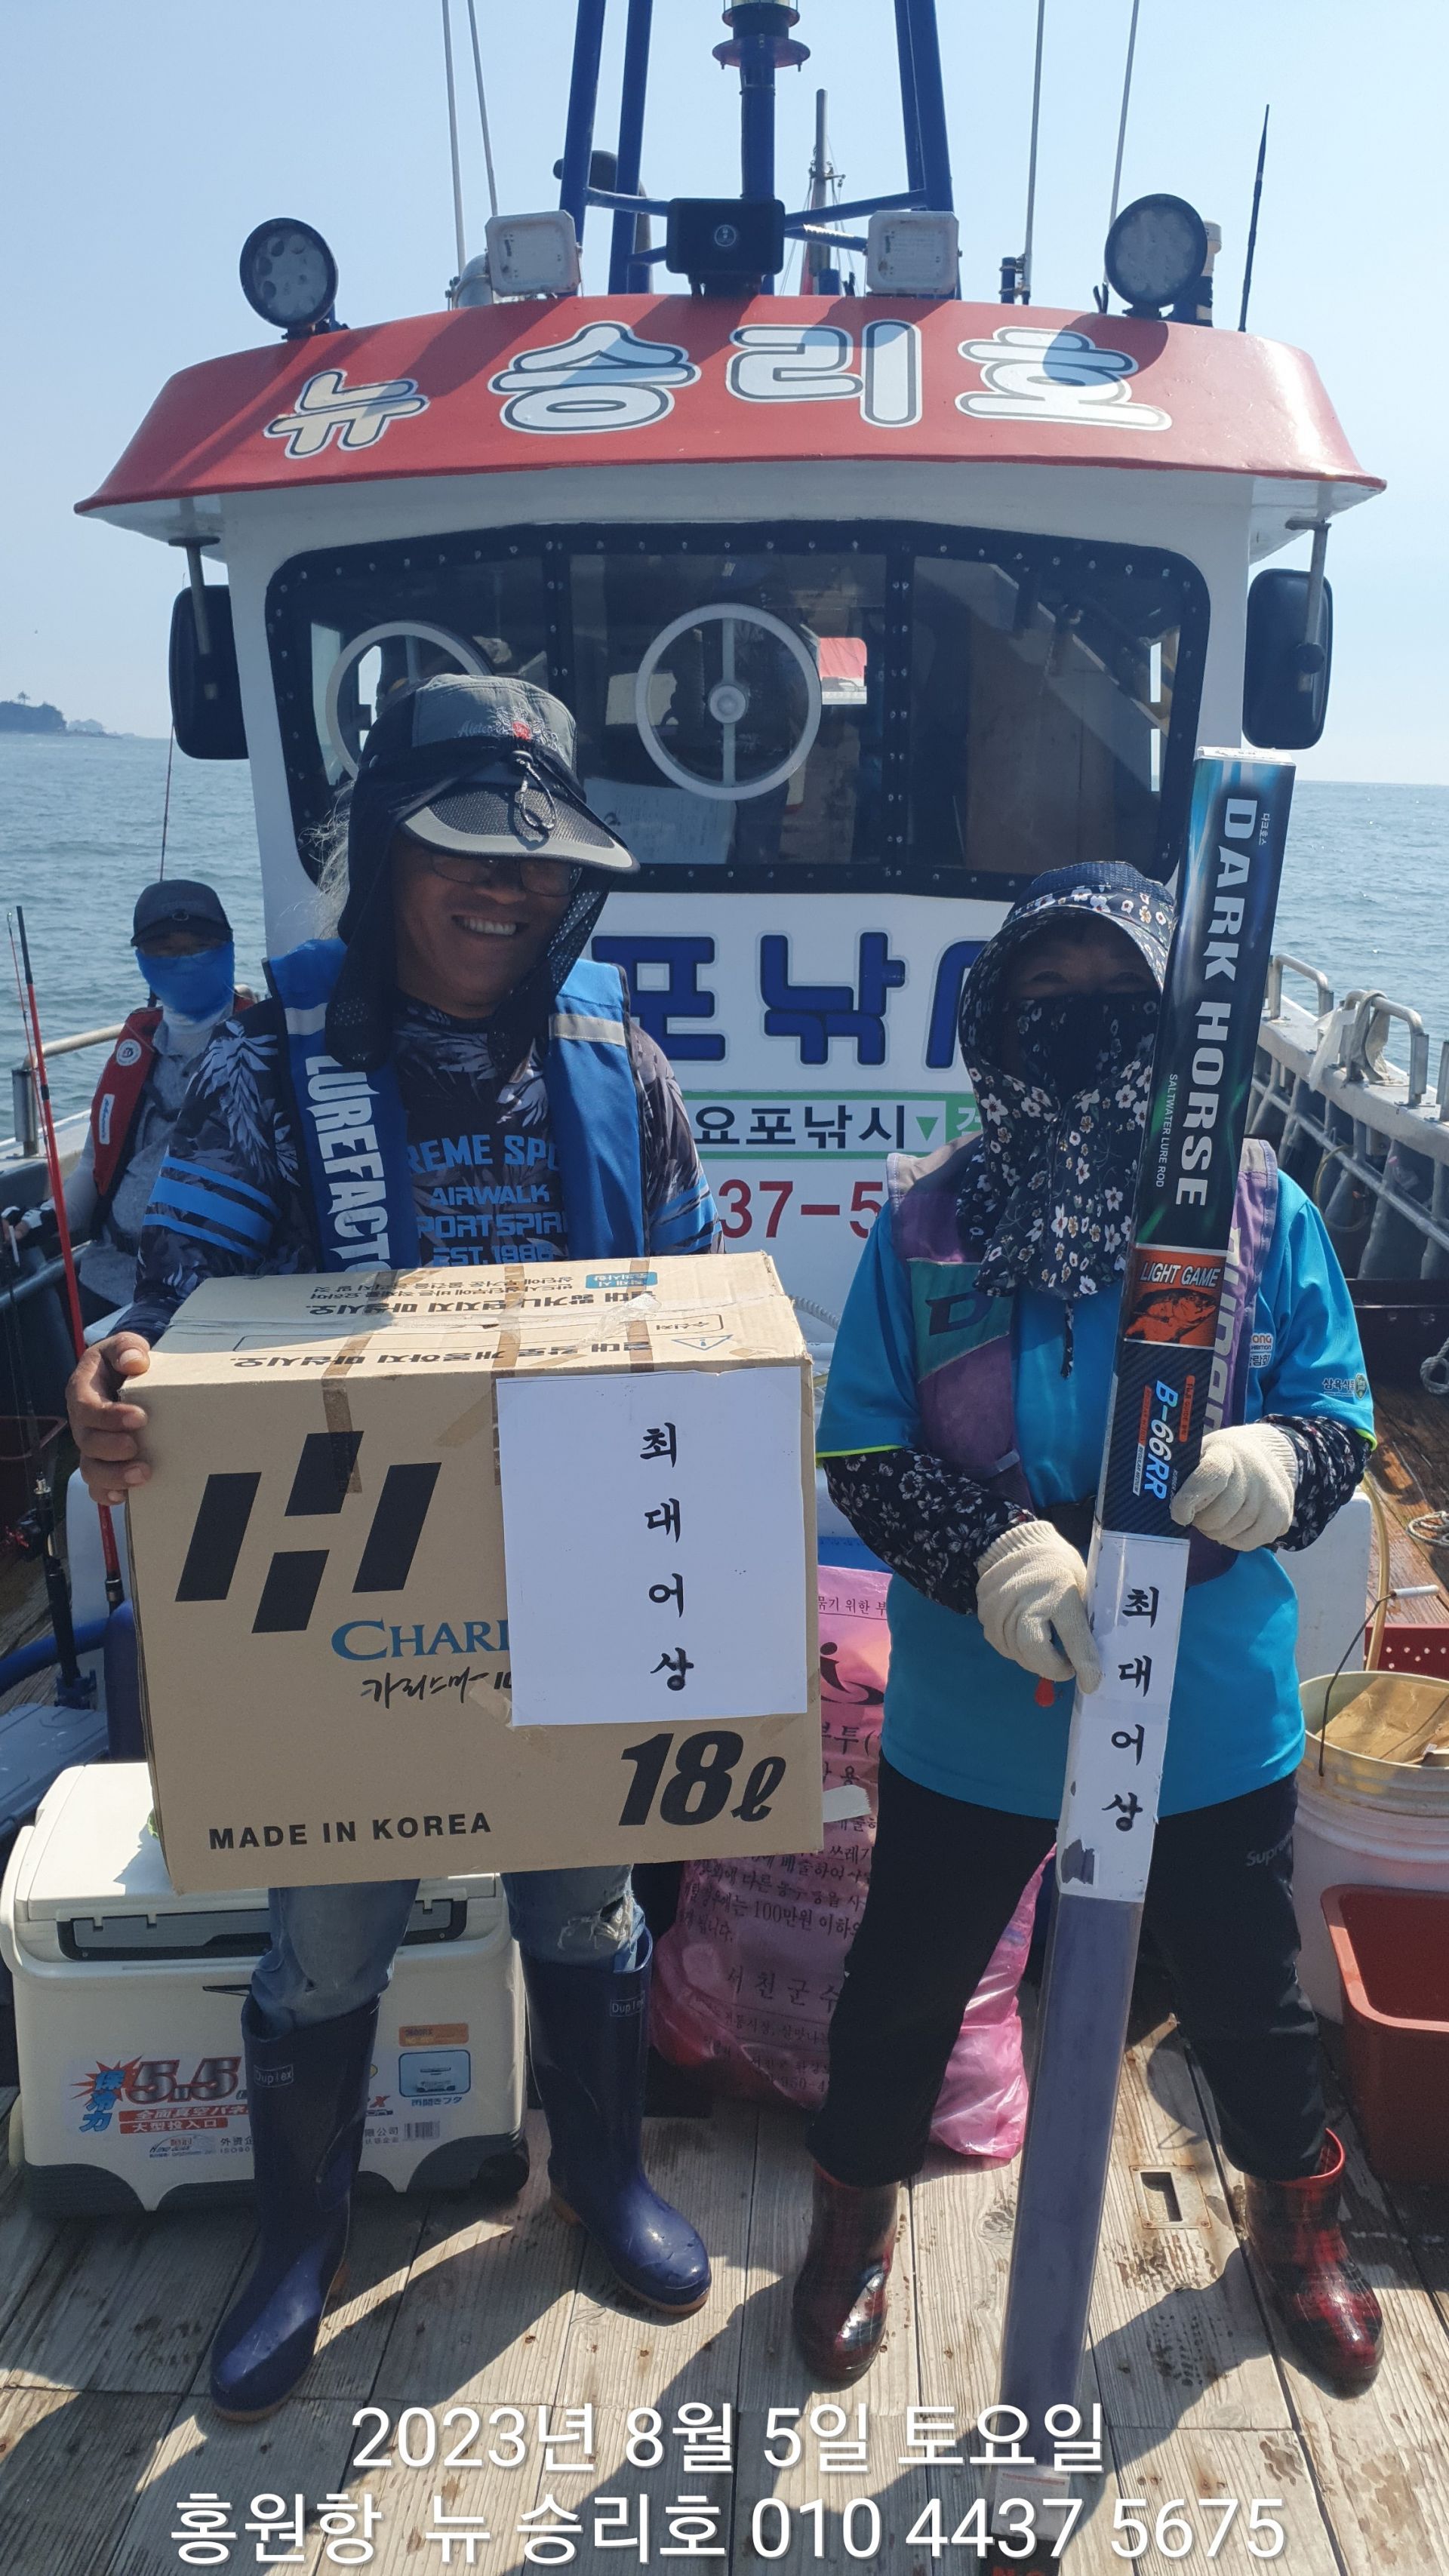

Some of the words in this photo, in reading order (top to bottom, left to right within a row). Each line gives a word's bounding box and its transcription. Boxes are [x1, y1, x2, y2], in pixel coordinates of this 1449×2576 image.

[263, 369, 429, 460] 뉴
[488, 319, 1172, 433] 승리호
[1257, 813, 1271, 846] 다크호스
[1201, 798, 1258, 982] DARK
[1162, 1073, 1178, 1135] SALTWATER
[1174, 1002, 1232, 1207] HORSE
[1158, 1136, 1171, 1164] LURE
[1155, 1166, 1167, 1188] ROD
[430, 1184, 550, 1206] AIRWALK
[432, 1246, 488, 1267] EST.
[1140, 1262, 1181, 1283] LIGHT
[1181, 1265, 1221, 1289] GAME
[427, 1299, 507, 1314] 던지지
[230, 1355, 366, 1368] 마십시오.
[377, 1350, 505, 1364] 개봉하지
[1144, 1380, 1178, 1500] B-66RR
[845, 1598, 870, 1615] 위한
[208, 1824, 308, 1852] MADE
[323, 1821, 358, 1844] IN
[372, 1812, 492, 1840] KOREA
[126, 2055, 242, 2104] 5.5
